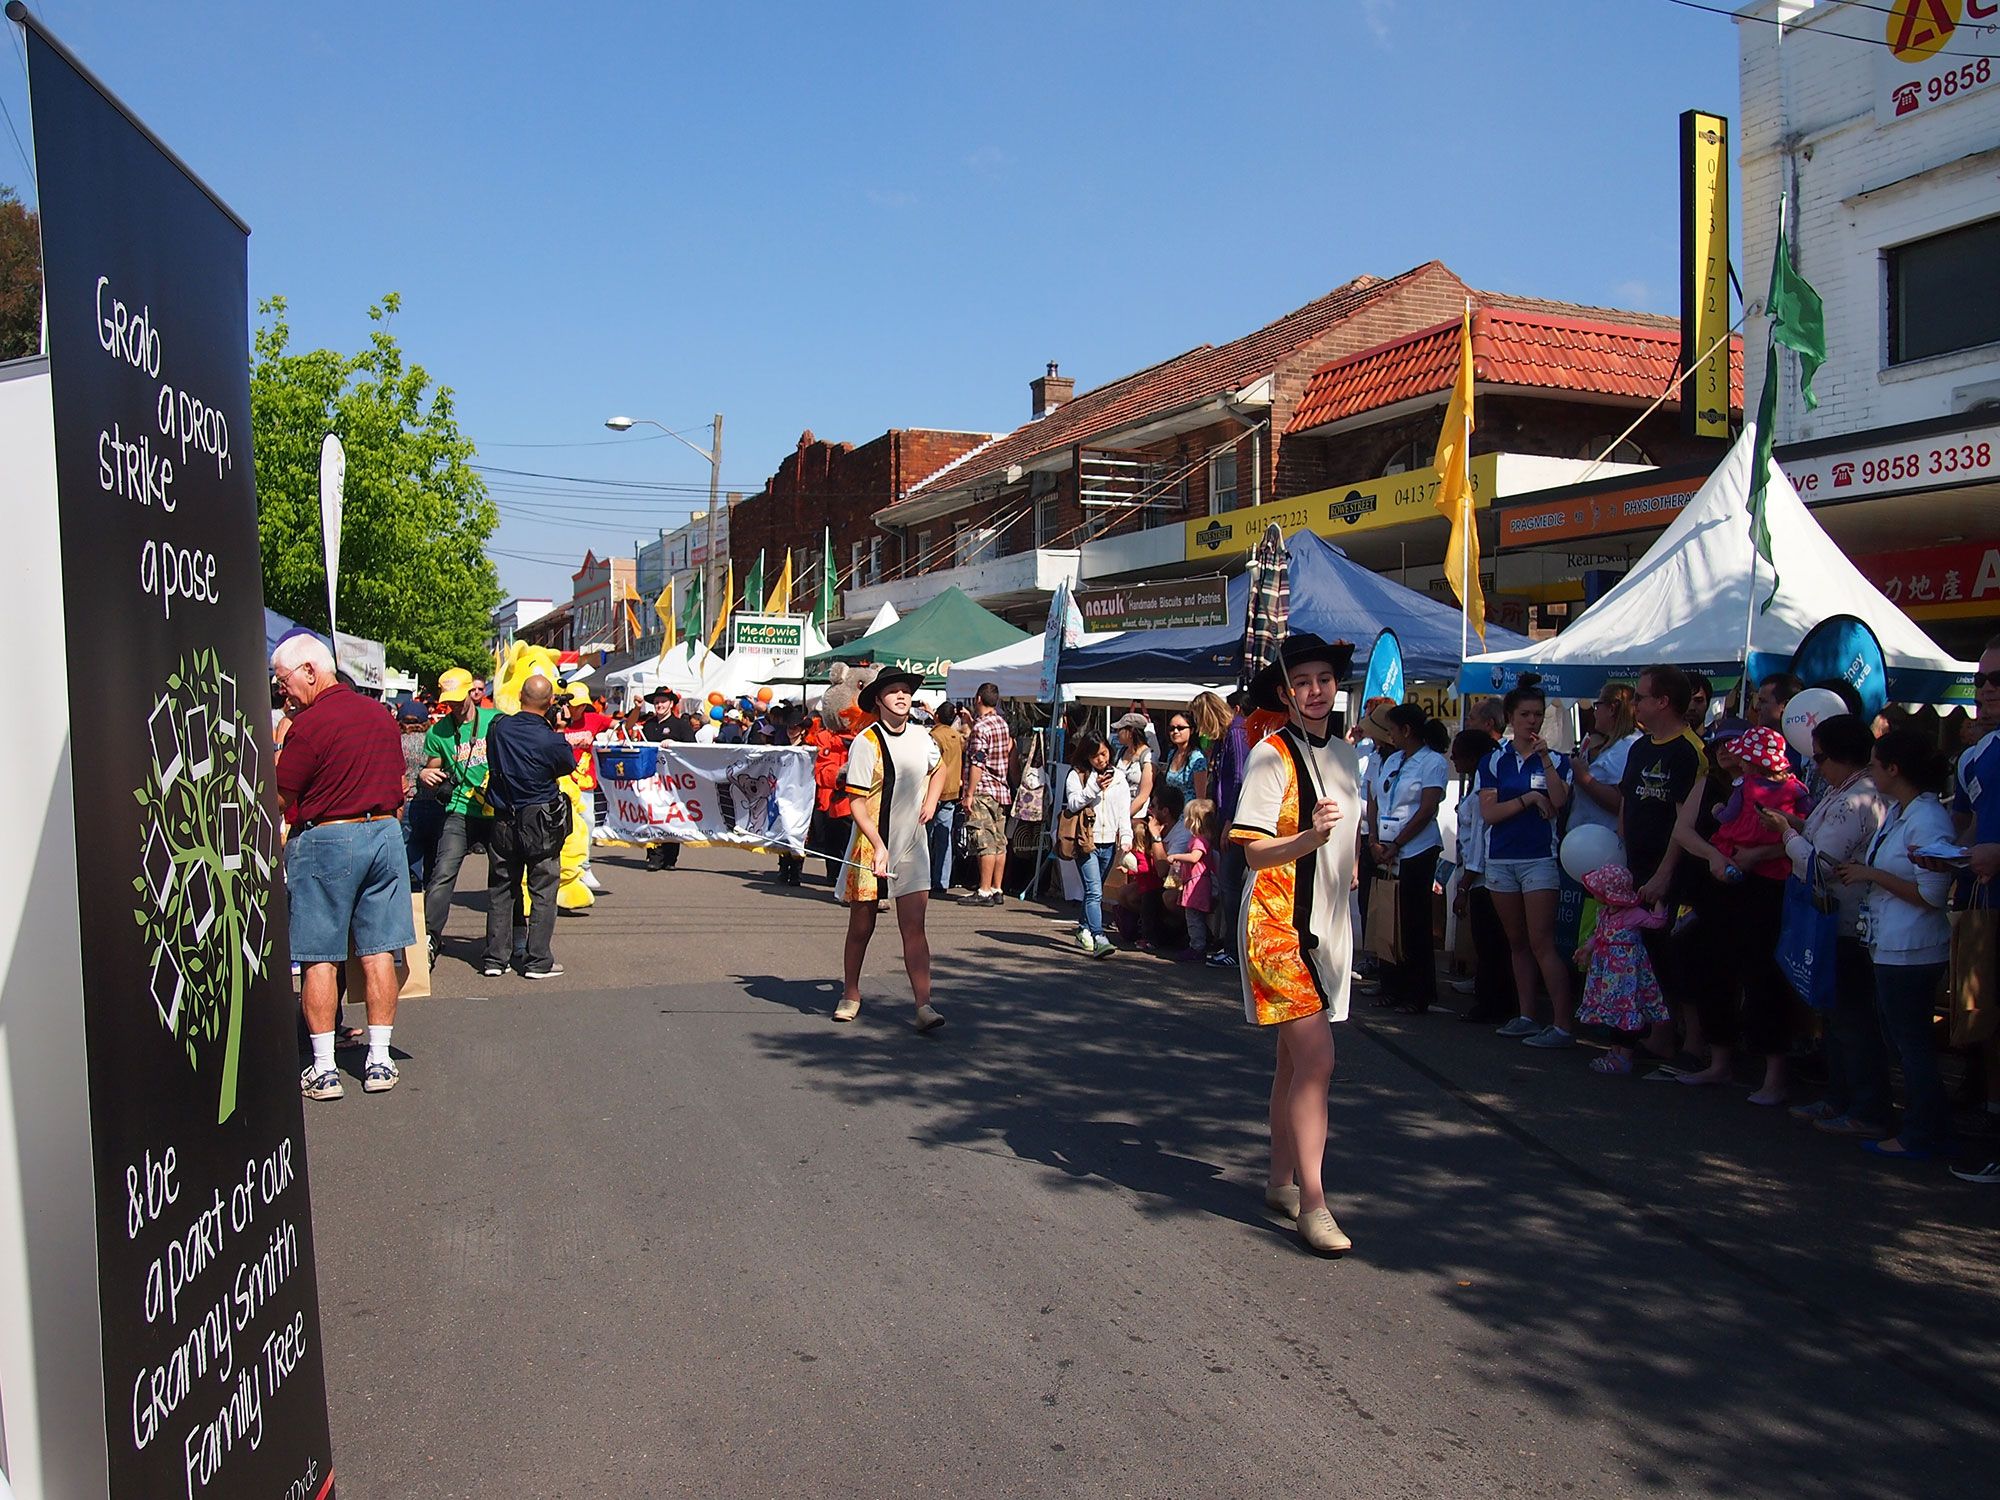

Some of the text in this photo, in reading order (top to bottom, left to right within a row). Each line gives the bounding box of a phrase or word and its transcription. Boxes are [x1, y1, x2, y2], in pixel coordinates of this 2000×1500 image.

[1928, 57, 1991, 102] 9858
[1707, 158, 1717, 394] 0413 772 223
[158, 383, 177, 437] a
[99, 422, 177, 513] strike
[1862, 453, 1920, 485] 9858
[1929, 442, 1991, 475] 3338
[1349, 500, 1374, 513] STREET
[1395, 485, 1425, 507] 0413
[1246, 517, 1268, 535] 0413
[1290, 509, 1309, 527] 223
[1510, 512, 1566, 532] PRAGMEDIC
[1567, 553, 1593, 568] Real
[141, 539, 219, 619] a pose
[1086, 593, 1125, 617] nazuk
[1128, 591, 1221, 611] Handmade Biscuits and Pastries
[740, 625, 799, 637] Medowie
[740, 636, 798, 645] MACADAMIAS
[896, 657, 954, 677] Medo
[619, 800, 704, 825] KOALAS
[145, 1136, 294, 1325] a part of our
[132, 1218, 299, 1451] Granny Smith
[184, 1310, 307, 1500] Family Tree
